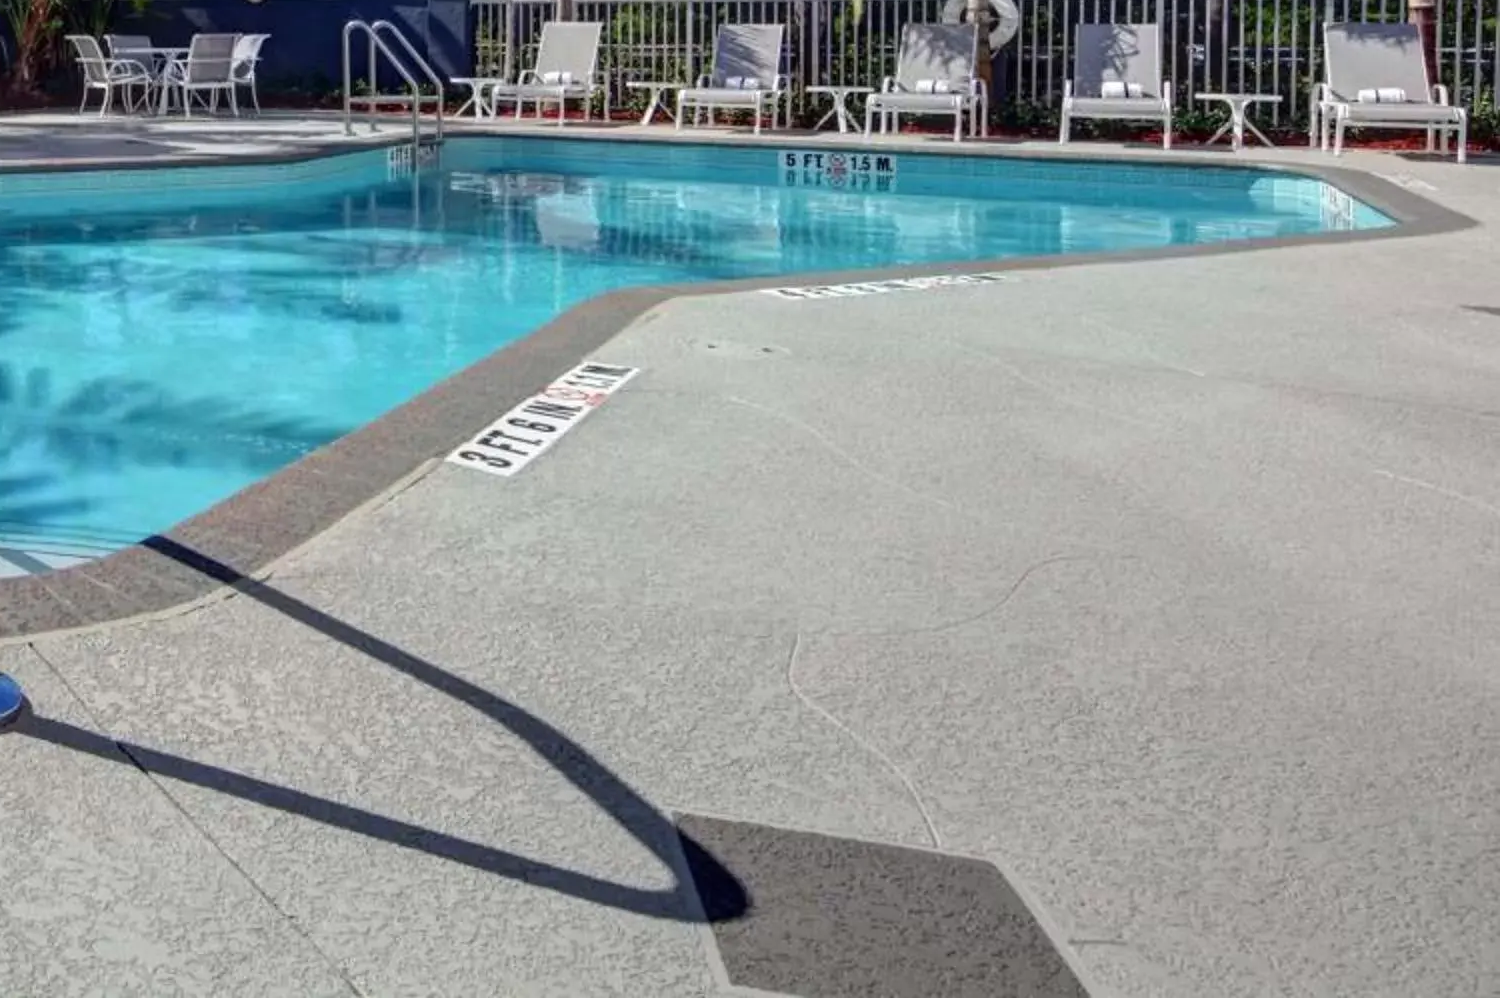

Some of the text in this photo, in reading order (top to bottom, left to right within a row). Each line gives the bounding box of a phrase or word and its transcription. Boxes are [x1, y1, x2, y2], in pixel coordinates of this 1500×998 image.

[786, 153, 796, 167] 5
[459, 450, 512, 468] 3
[508, 417, 557, 433] 6
